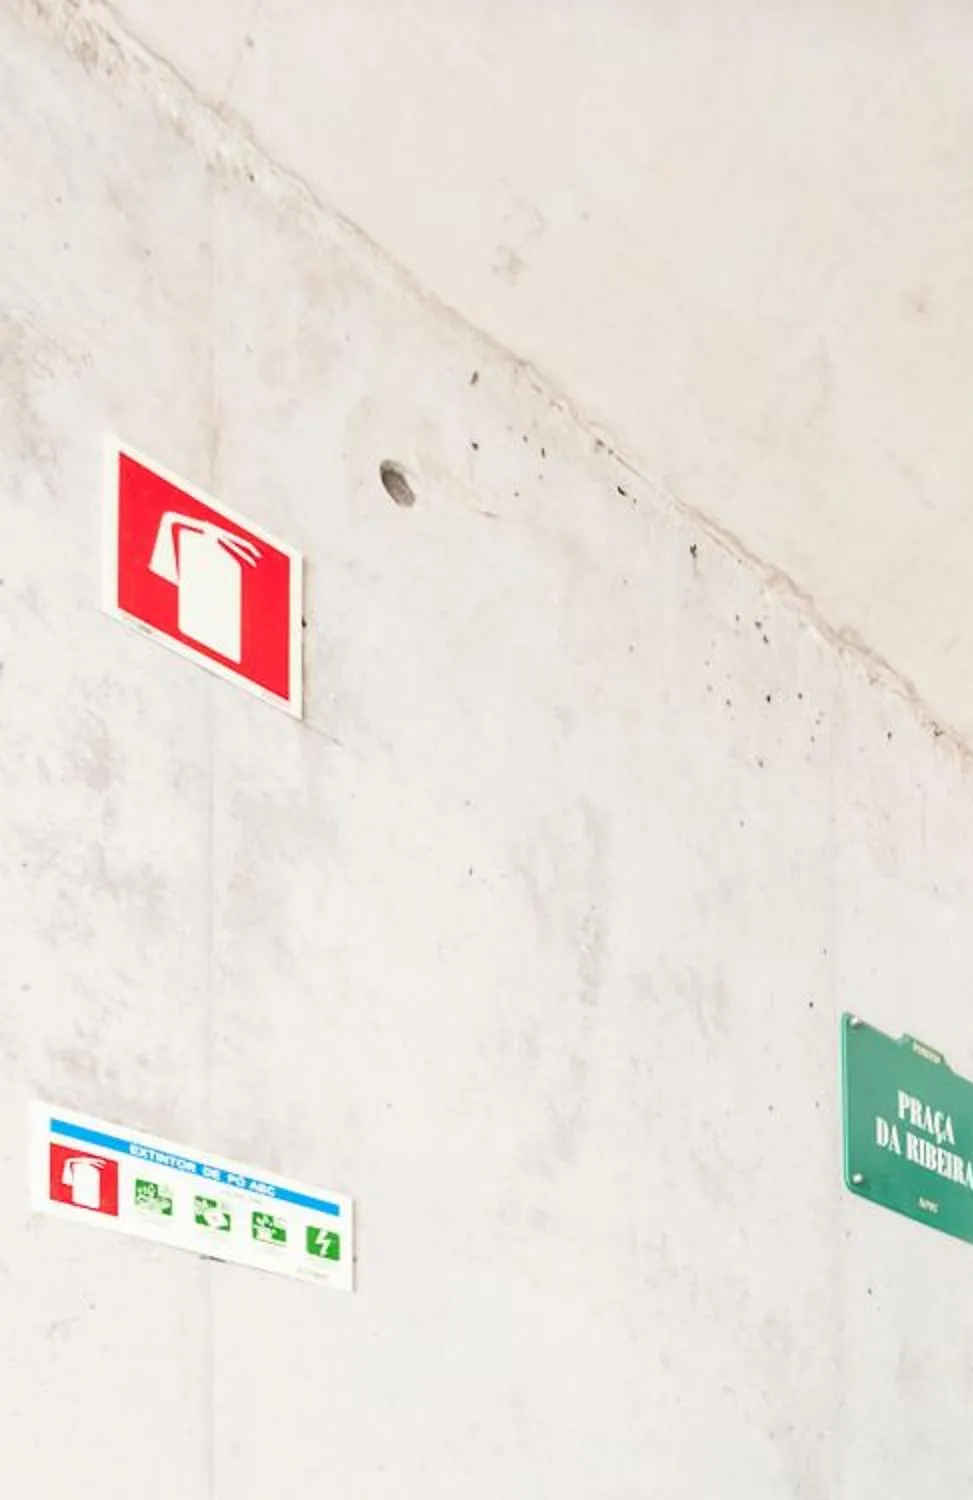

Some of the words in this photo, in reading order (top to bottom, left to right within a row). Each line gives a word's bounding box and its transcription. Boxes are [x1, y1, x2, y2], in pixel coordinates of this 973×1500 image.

[876, 1115, 902, 1156] DA
[897, 1089, 955, 1146] PRAÇA
[129, 1143, 197, 1174] EXTINTOR
[202, 1164, 221, 1182] DE
[249, 1179, 277, 1199] ABC
